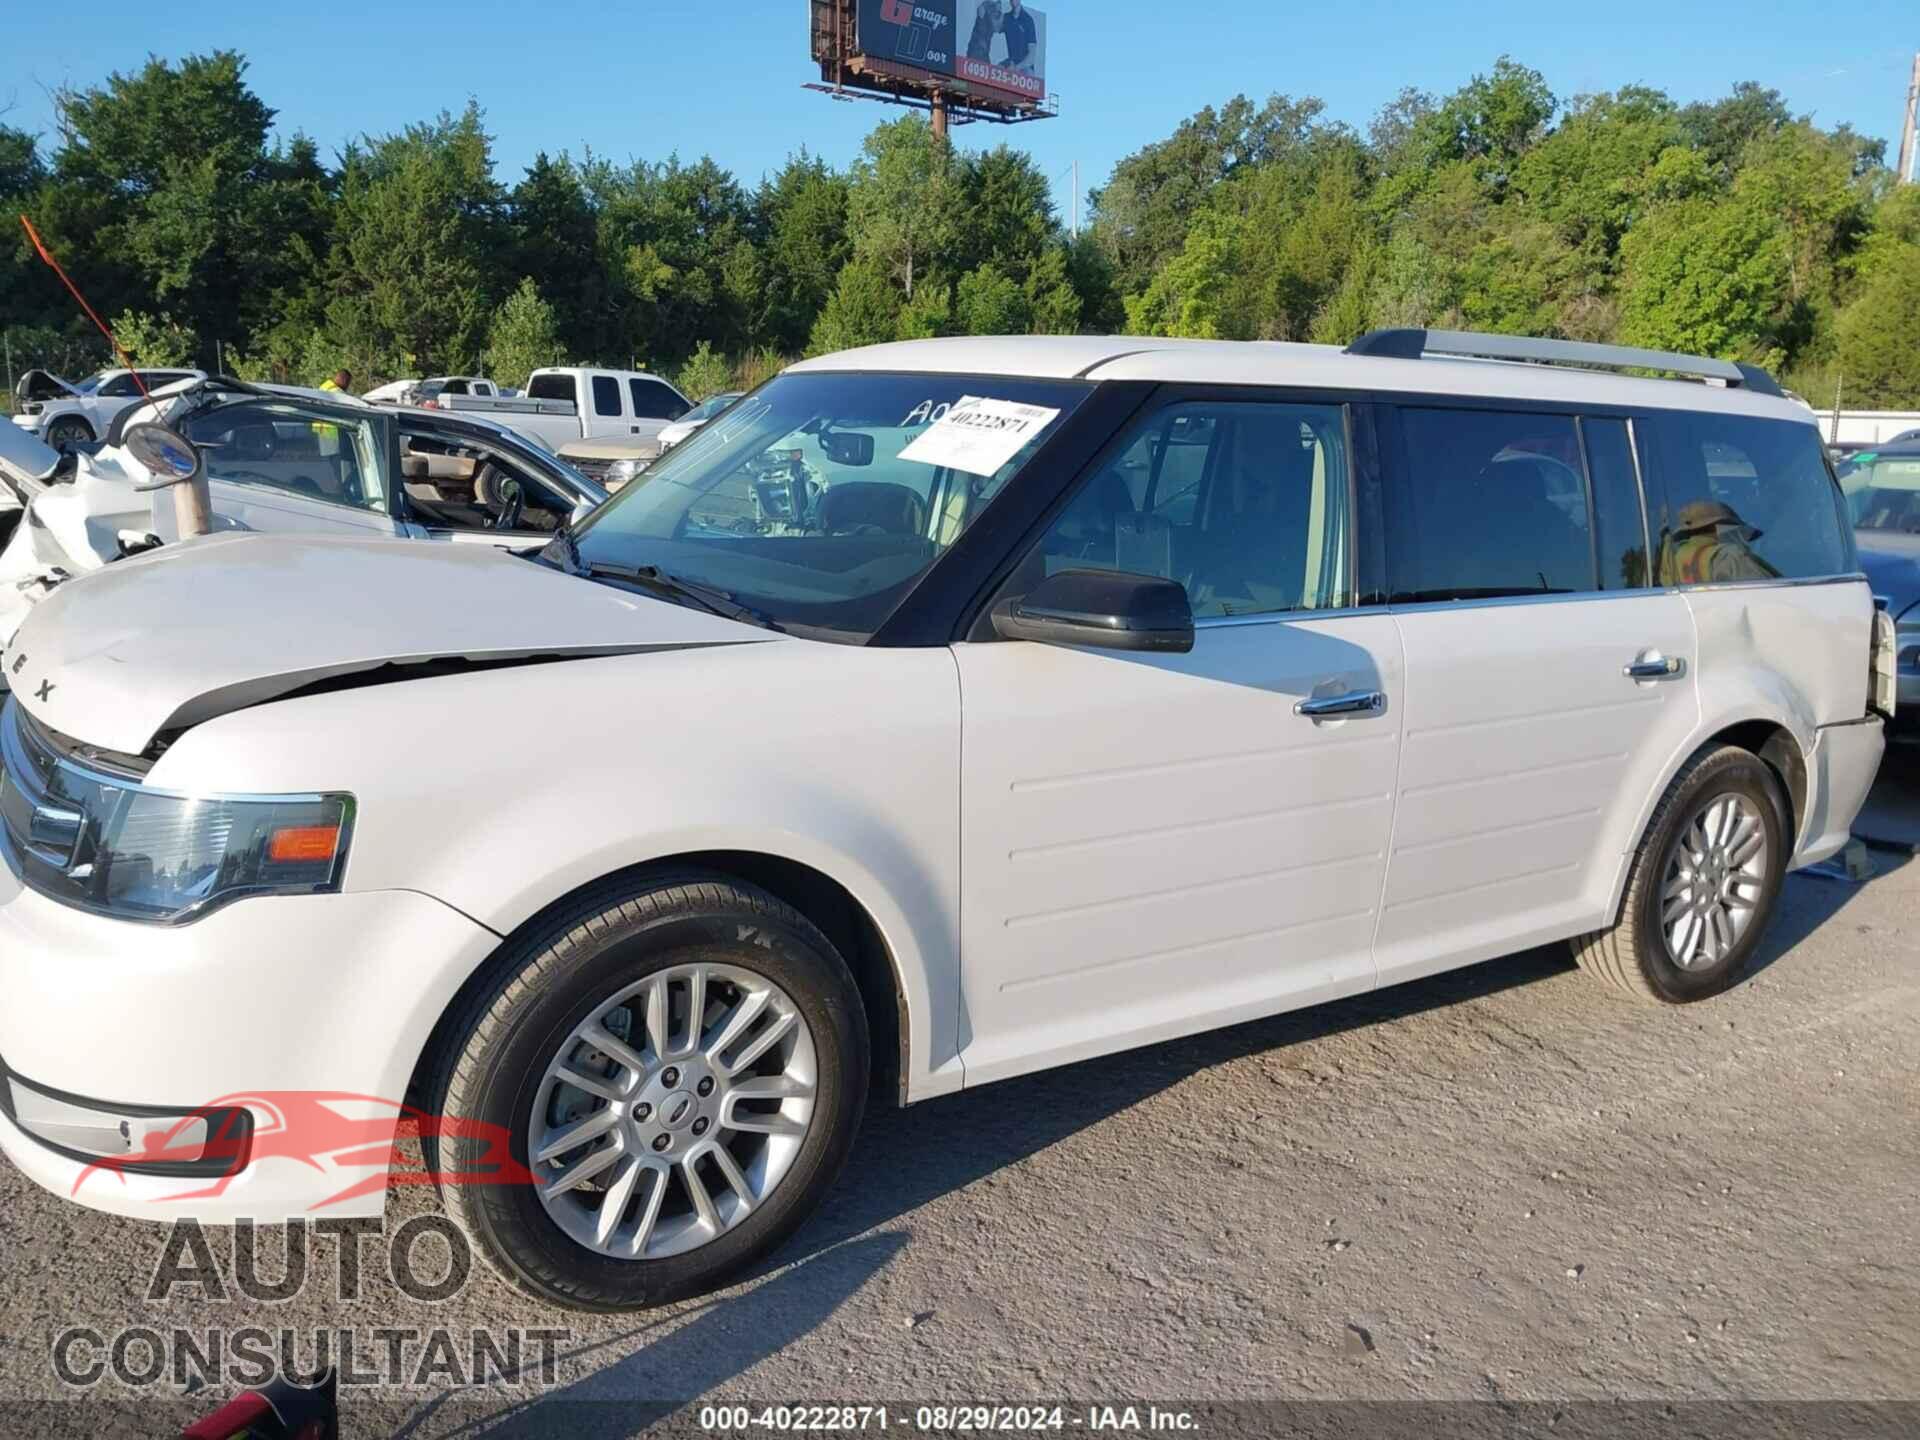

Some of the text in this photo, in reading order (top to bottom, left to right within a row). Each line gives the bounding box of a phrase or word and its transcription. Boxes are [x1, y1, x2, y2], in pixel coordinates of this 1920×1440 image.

[963, 61, 1041, 92] (405) 525-DOOR
[950, 411, 1029, 433] 40222871
